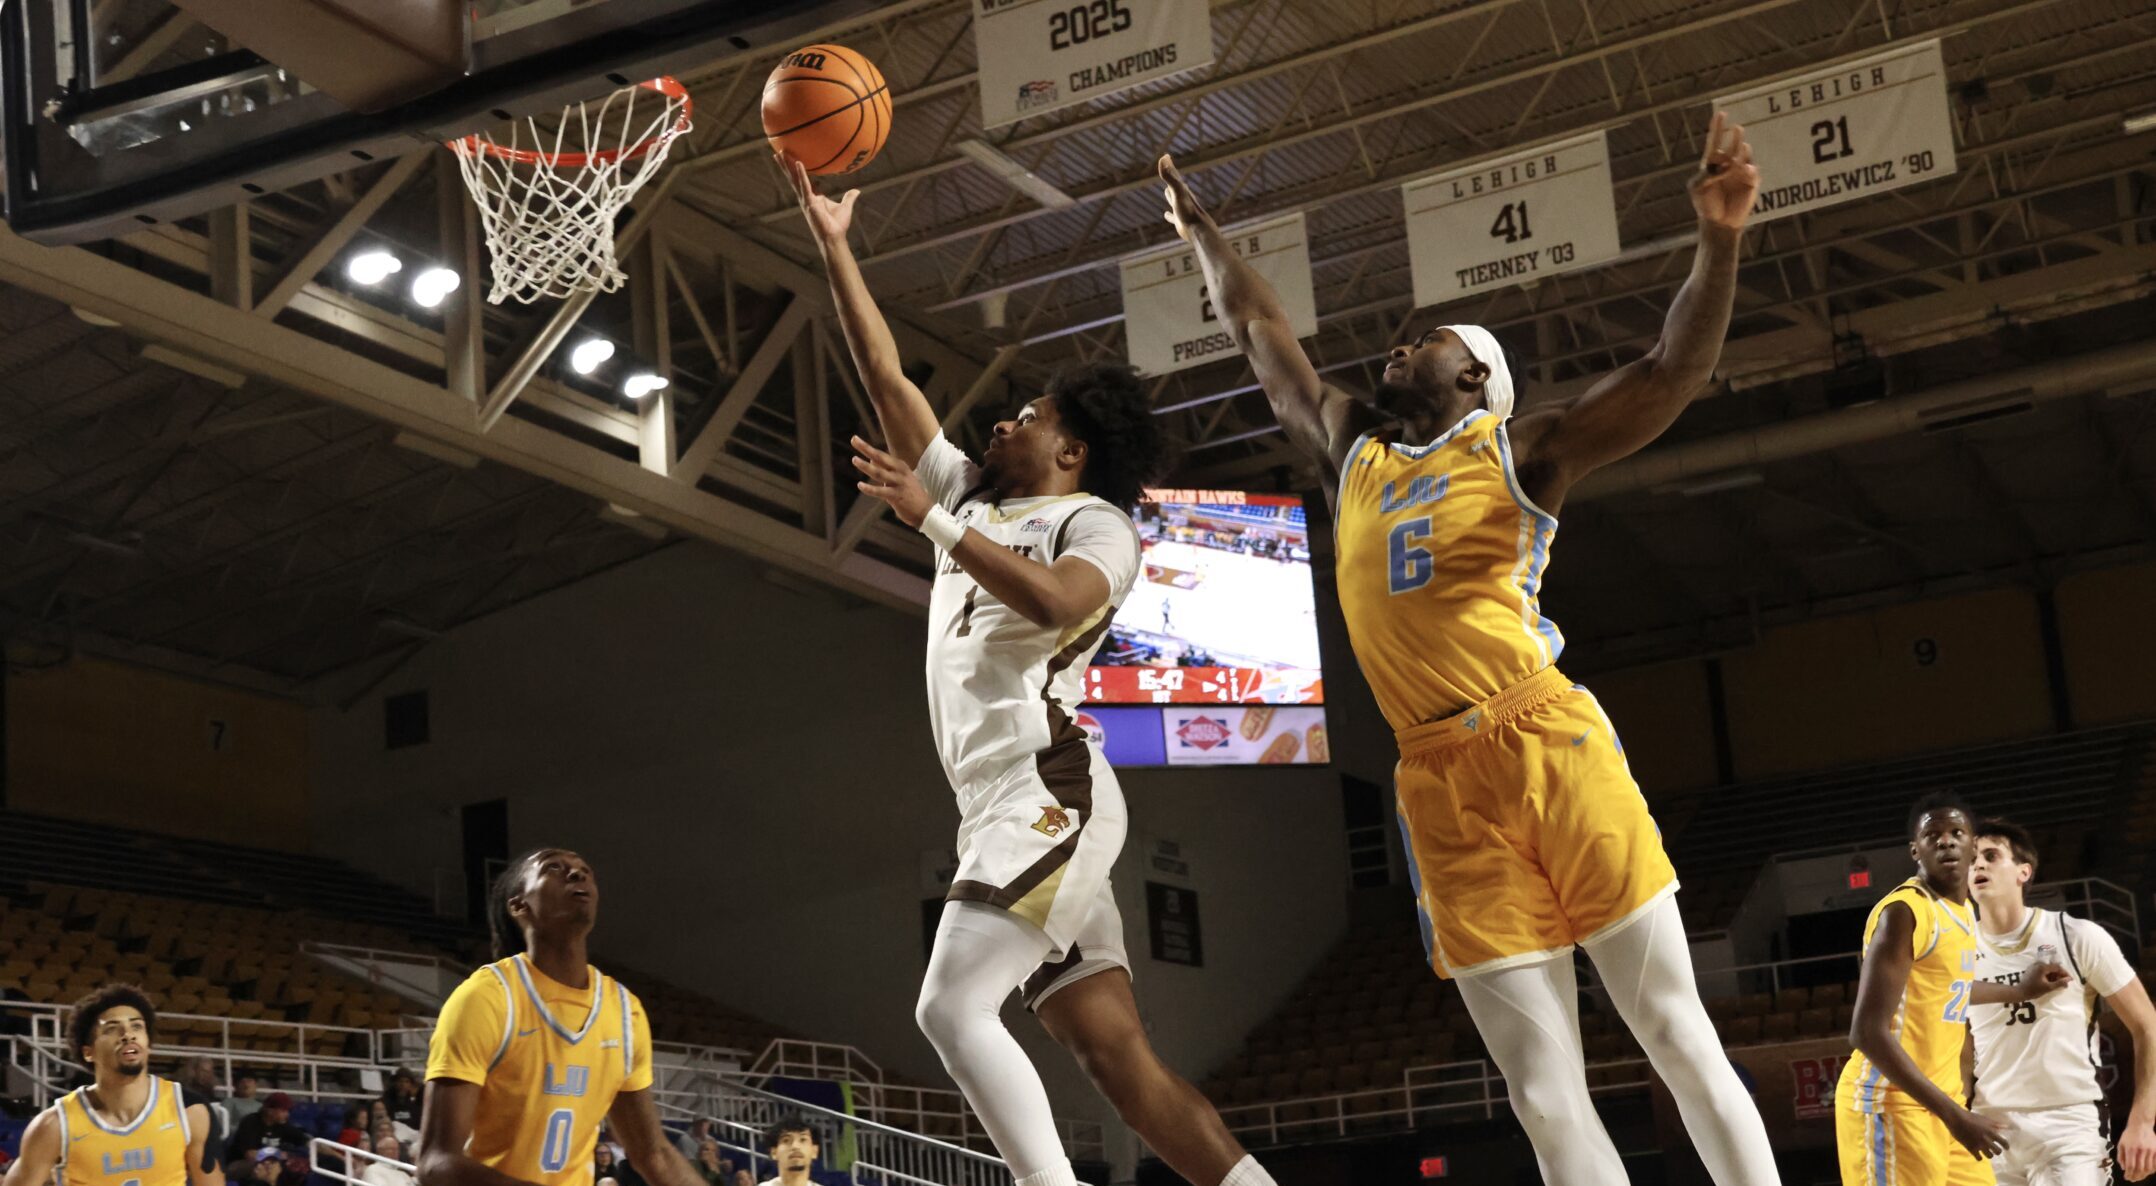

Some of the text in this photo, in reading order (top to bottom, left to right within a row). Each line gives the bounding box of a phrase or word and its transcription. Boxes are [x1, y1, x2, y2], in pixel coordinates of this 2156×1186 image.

[1049, 0, 1131, 50] 2025
[1069, 43, 1178, 93] CHAMPIONS
[1768, 67, 1885, 114] LEHIGH
[1811, 115, 1854, 165] 21
[1452, 155, 1557, 198] LEHIGH
[1901, 150, 1934, 175] '90
[1490, 200, 1532, 244] 41
[1164, 236, 1261, 277] LEGH
[1455, 242, 1575, 288] TIERNEY '03
[1173, 331, 1237, 362] PROSSE
[1199, 490, 1246, 505] HAWKS
[1380, 474, 1450, 513] LIU
[1388, 515, 1435, 596] 6
[956, 584, 978, 638] 1
[1914, 638, 1937, 666] 9
[209, 719, 225, 751] 7
[2004, 1001, 2036, 1026] 35
[543, 1063, 590, 1097] LIU
[101, 1146, 155, 1176] LIU
[539, 1108, 574, 1174] 0
